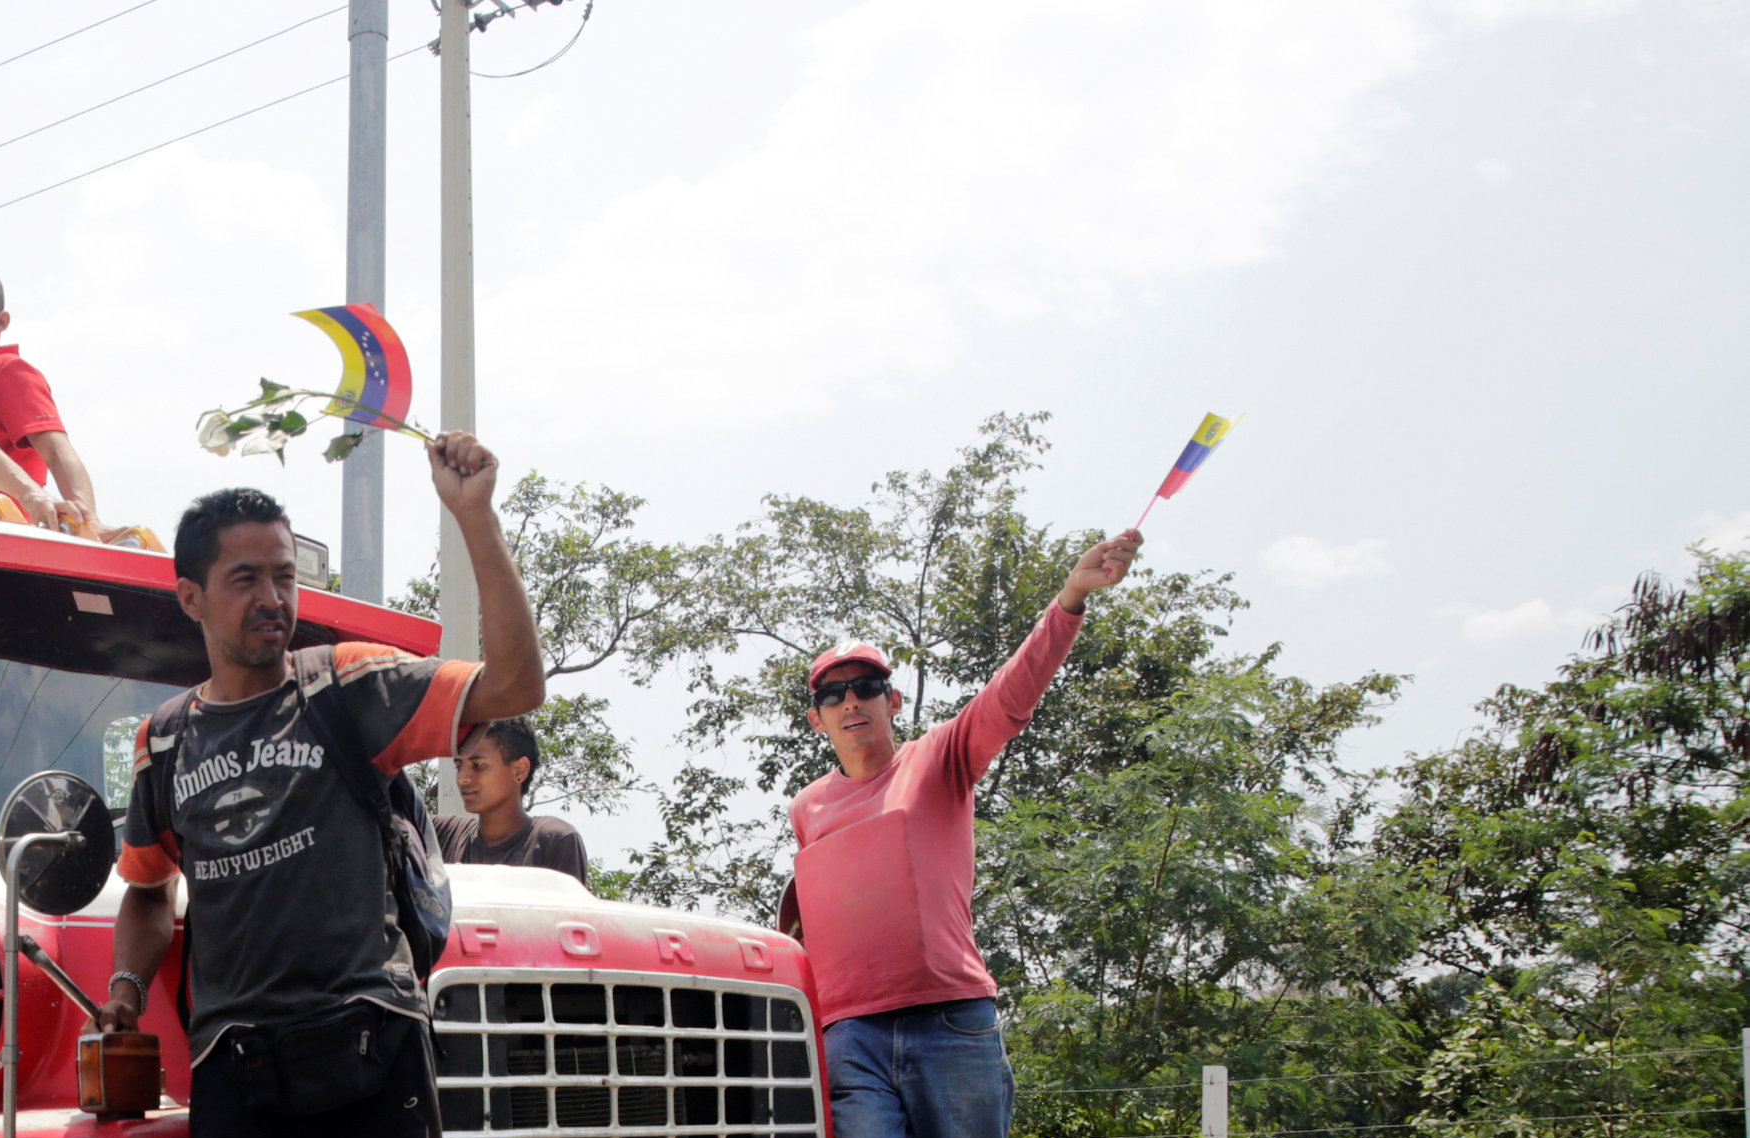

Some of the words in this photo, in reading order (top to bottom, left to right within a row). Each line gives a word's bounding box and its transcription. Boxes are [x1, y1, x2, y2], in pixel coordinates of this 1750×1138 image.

[173, 750, 242, 811] Ammos
[246, 738, 324, 773] Jeans
[194, 826, 315, 880] HEAVYWEIGHT
[455, 918, 774, 973] FORD
